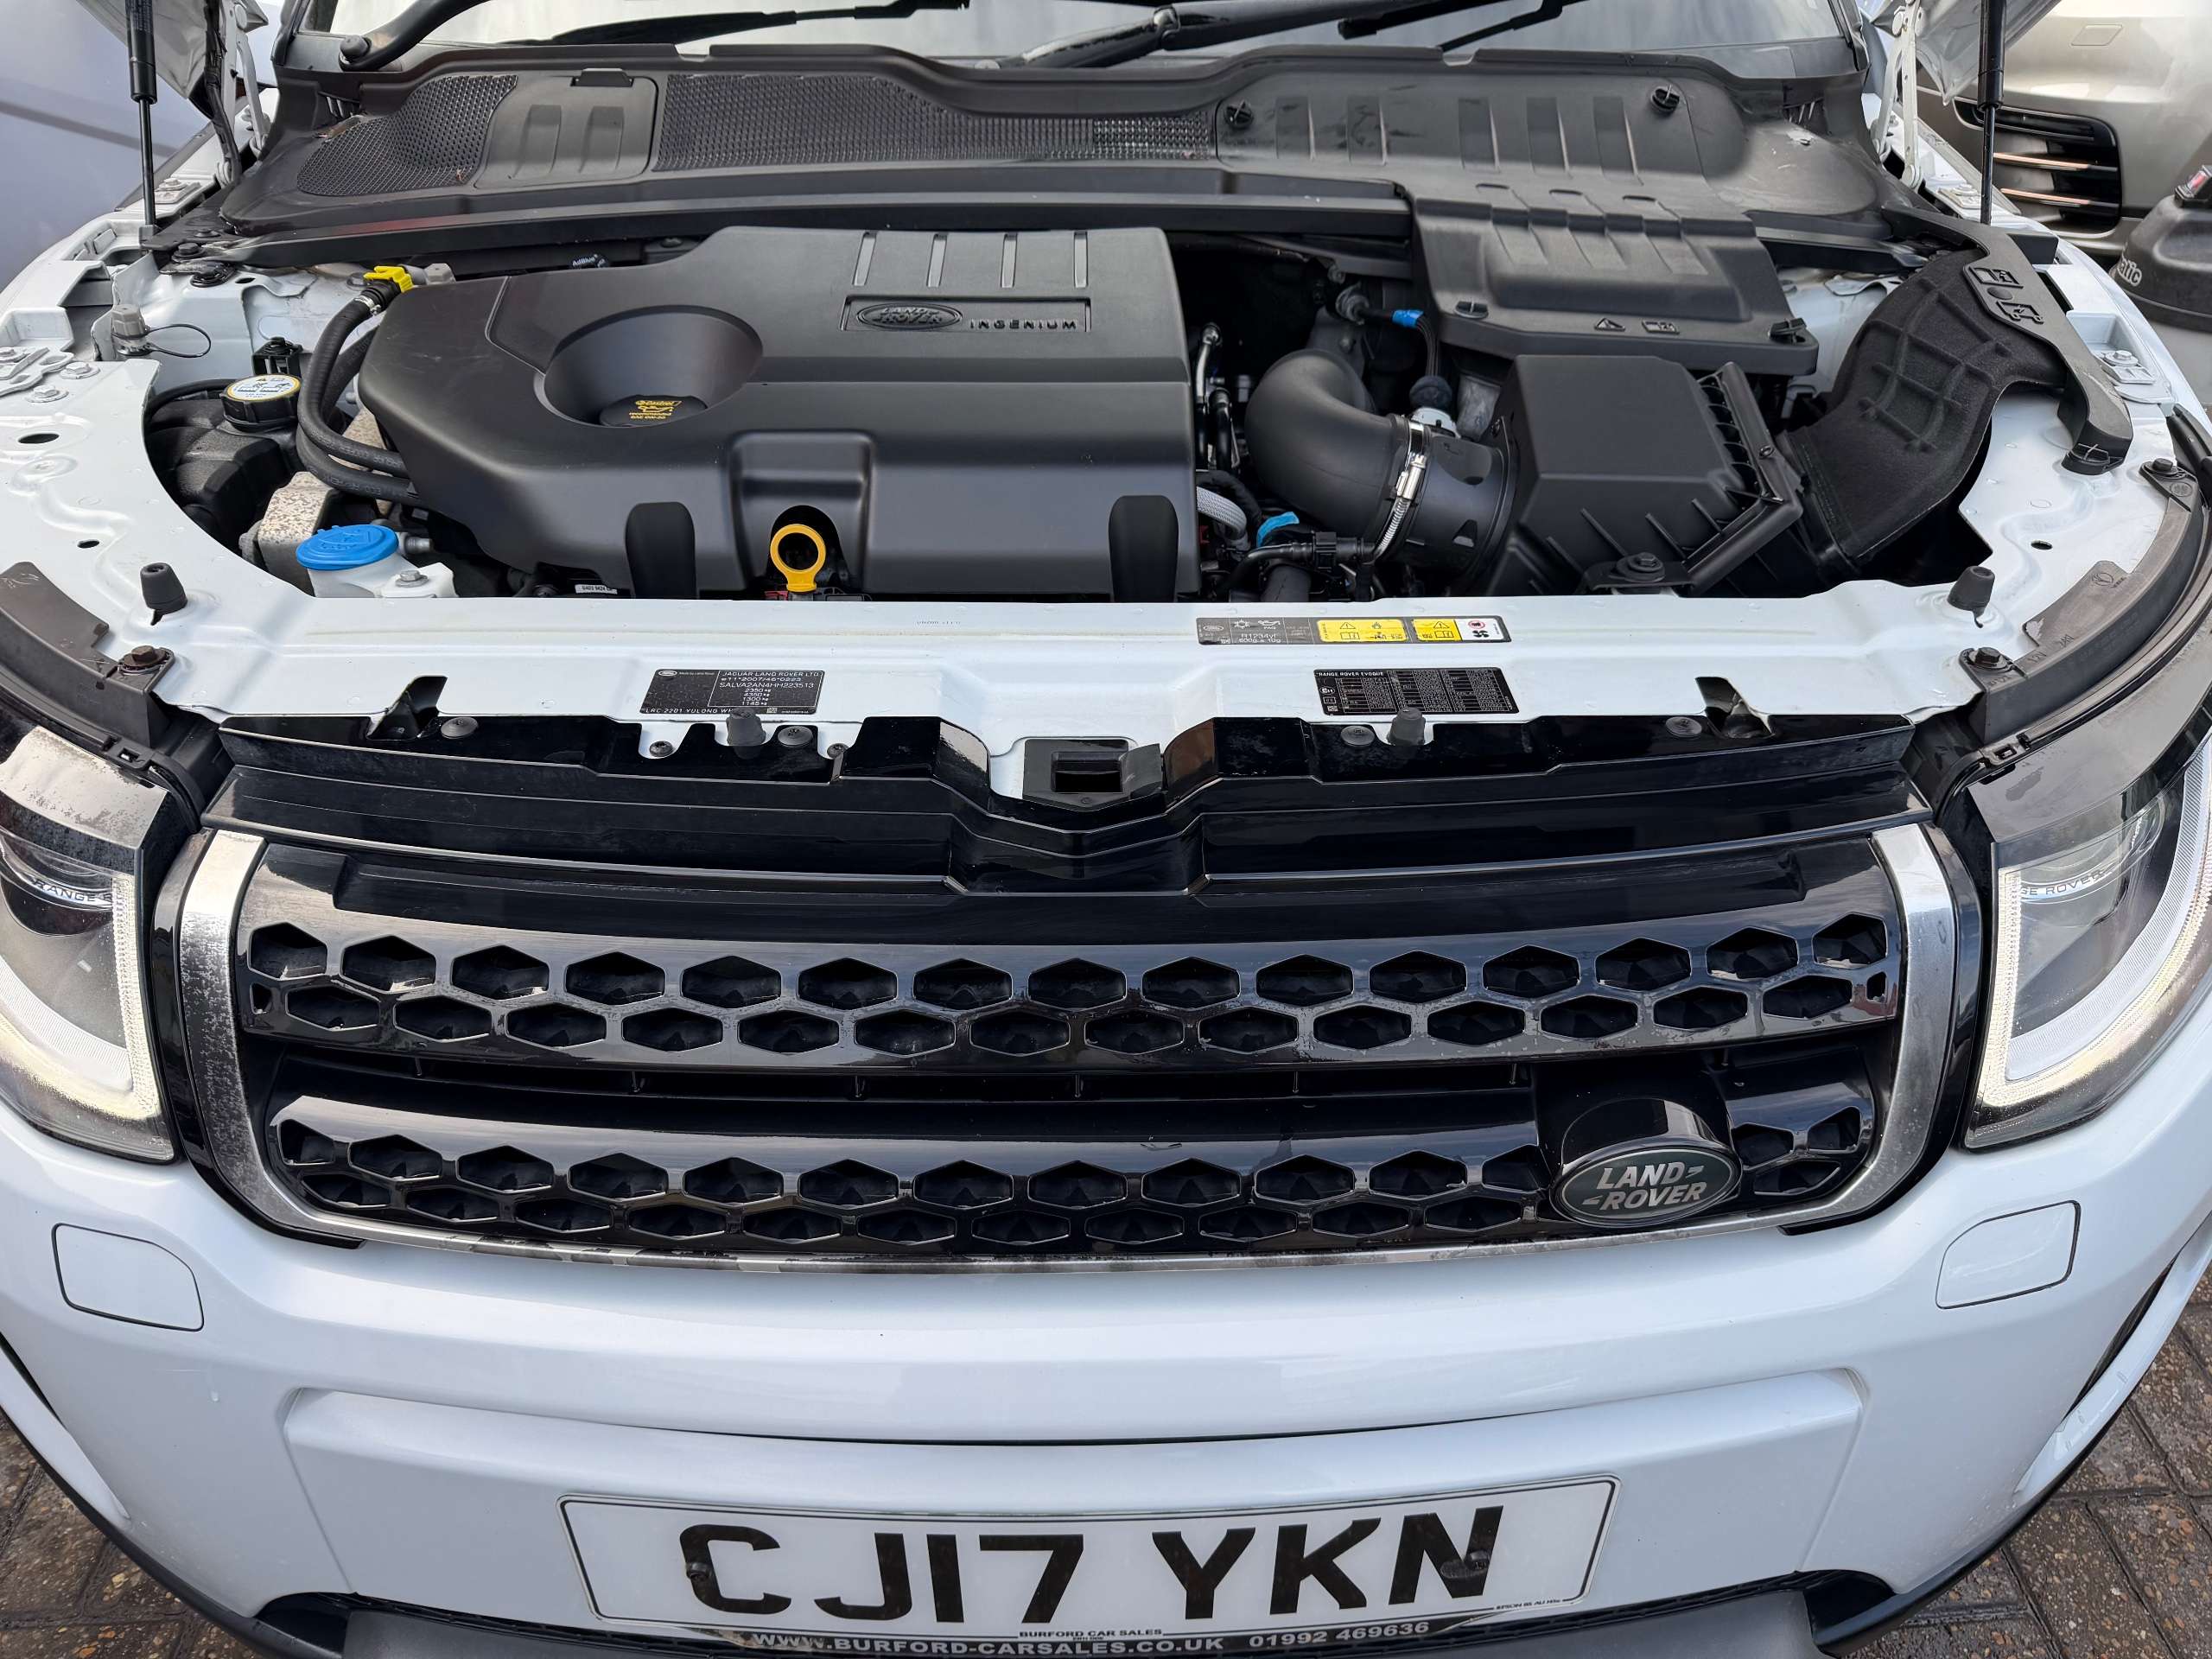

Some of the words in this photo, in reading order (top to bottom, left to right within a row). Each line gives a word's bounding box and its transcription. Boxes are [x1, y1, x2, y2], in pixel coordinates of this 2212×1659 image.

[969, 318, 1077, 330] INGENIUM
[2045, 870, 2102, 895] ROVER
[1596, 1161, 1685, 1190] LAND
[1599, 1181, 1707, 1211] ROVER
[679, 1523, 1084, 1624] CJ17
[1152, 1505, 1504, 1620] YKN
[752, 1632, 1225, 1656] WWW.BURFORD-CARSALES.CO.UK
[1249, 1630, 1327, 1649] 01992
[1335, 1621, 1430, 1642] 469636
